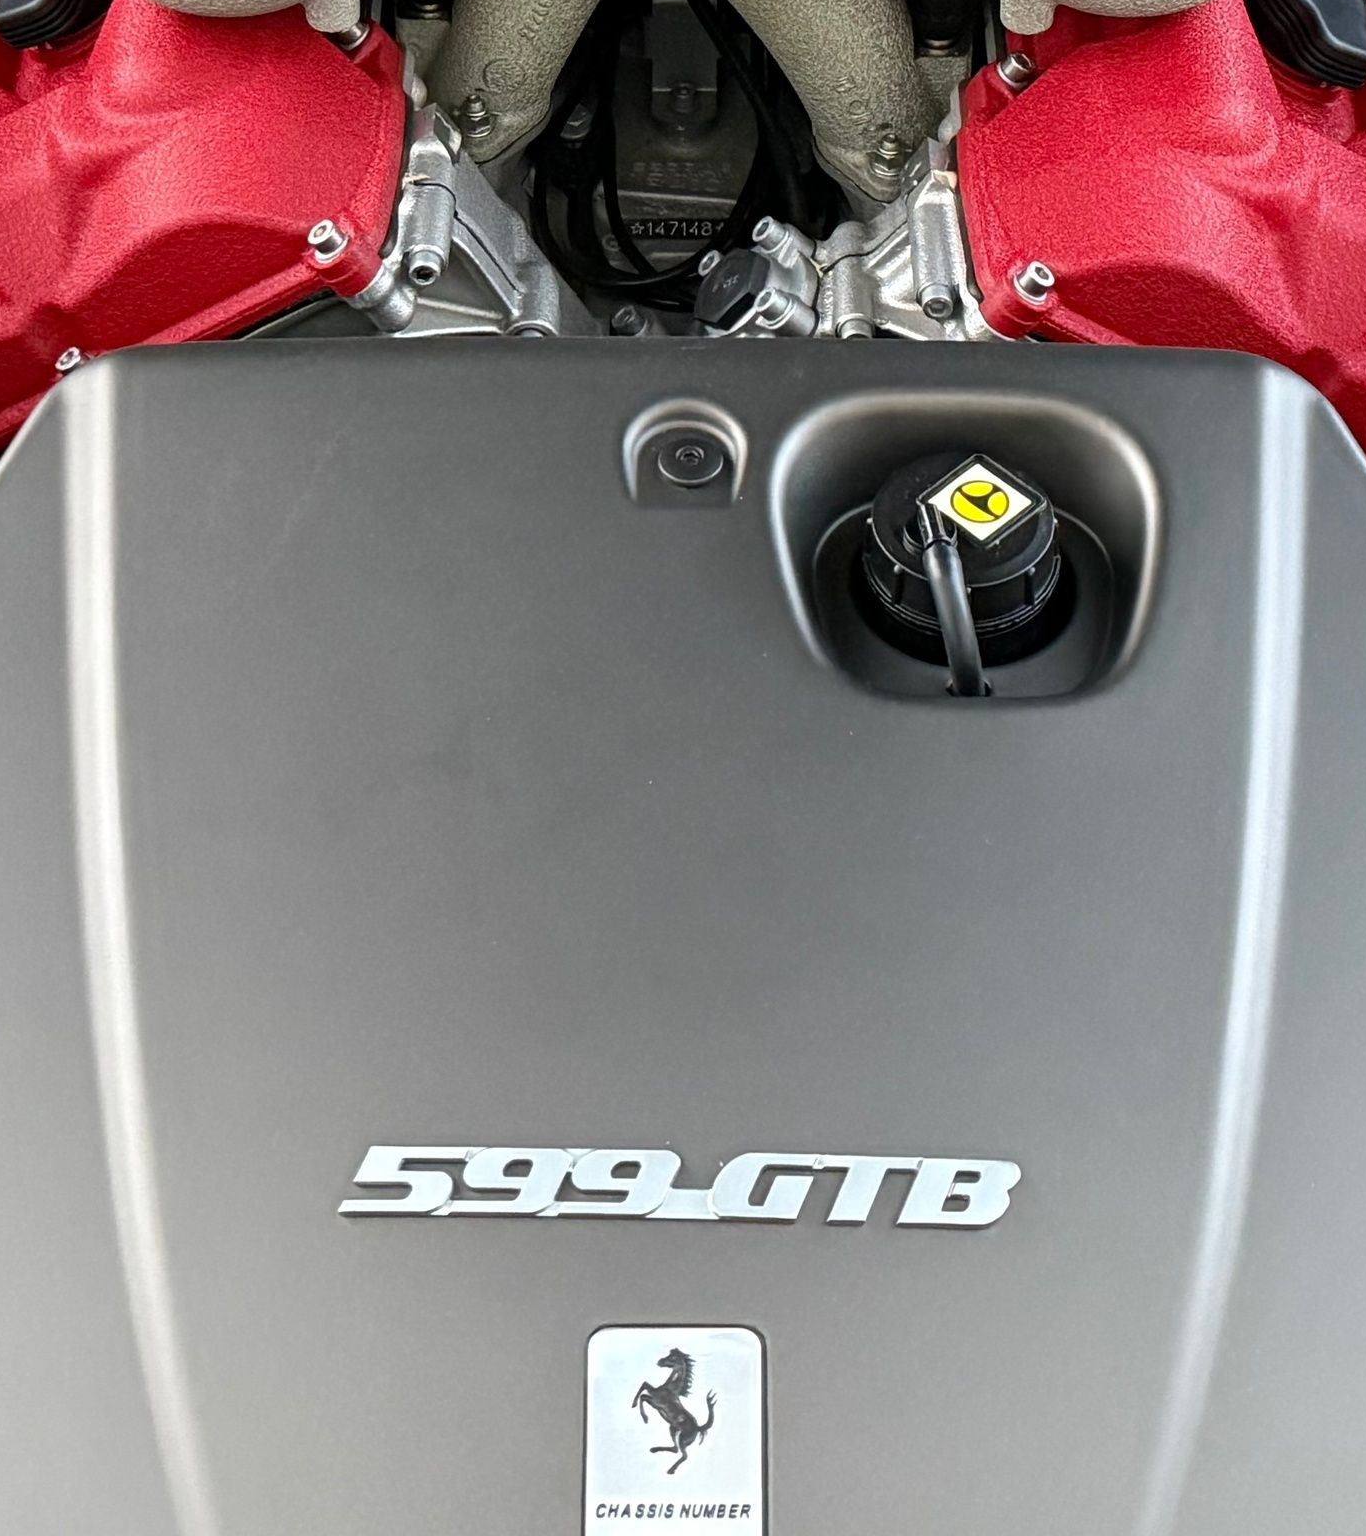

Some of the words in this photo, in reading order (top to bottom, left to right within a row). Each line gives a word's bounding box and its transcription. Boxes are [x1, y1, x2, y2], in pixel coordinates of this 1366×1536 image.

[714, 1151, 1022, 1229] GTB
[596, 1503, 674, 1519] CHASSIS
[679, 1503, 752, 1519] NUMBER
